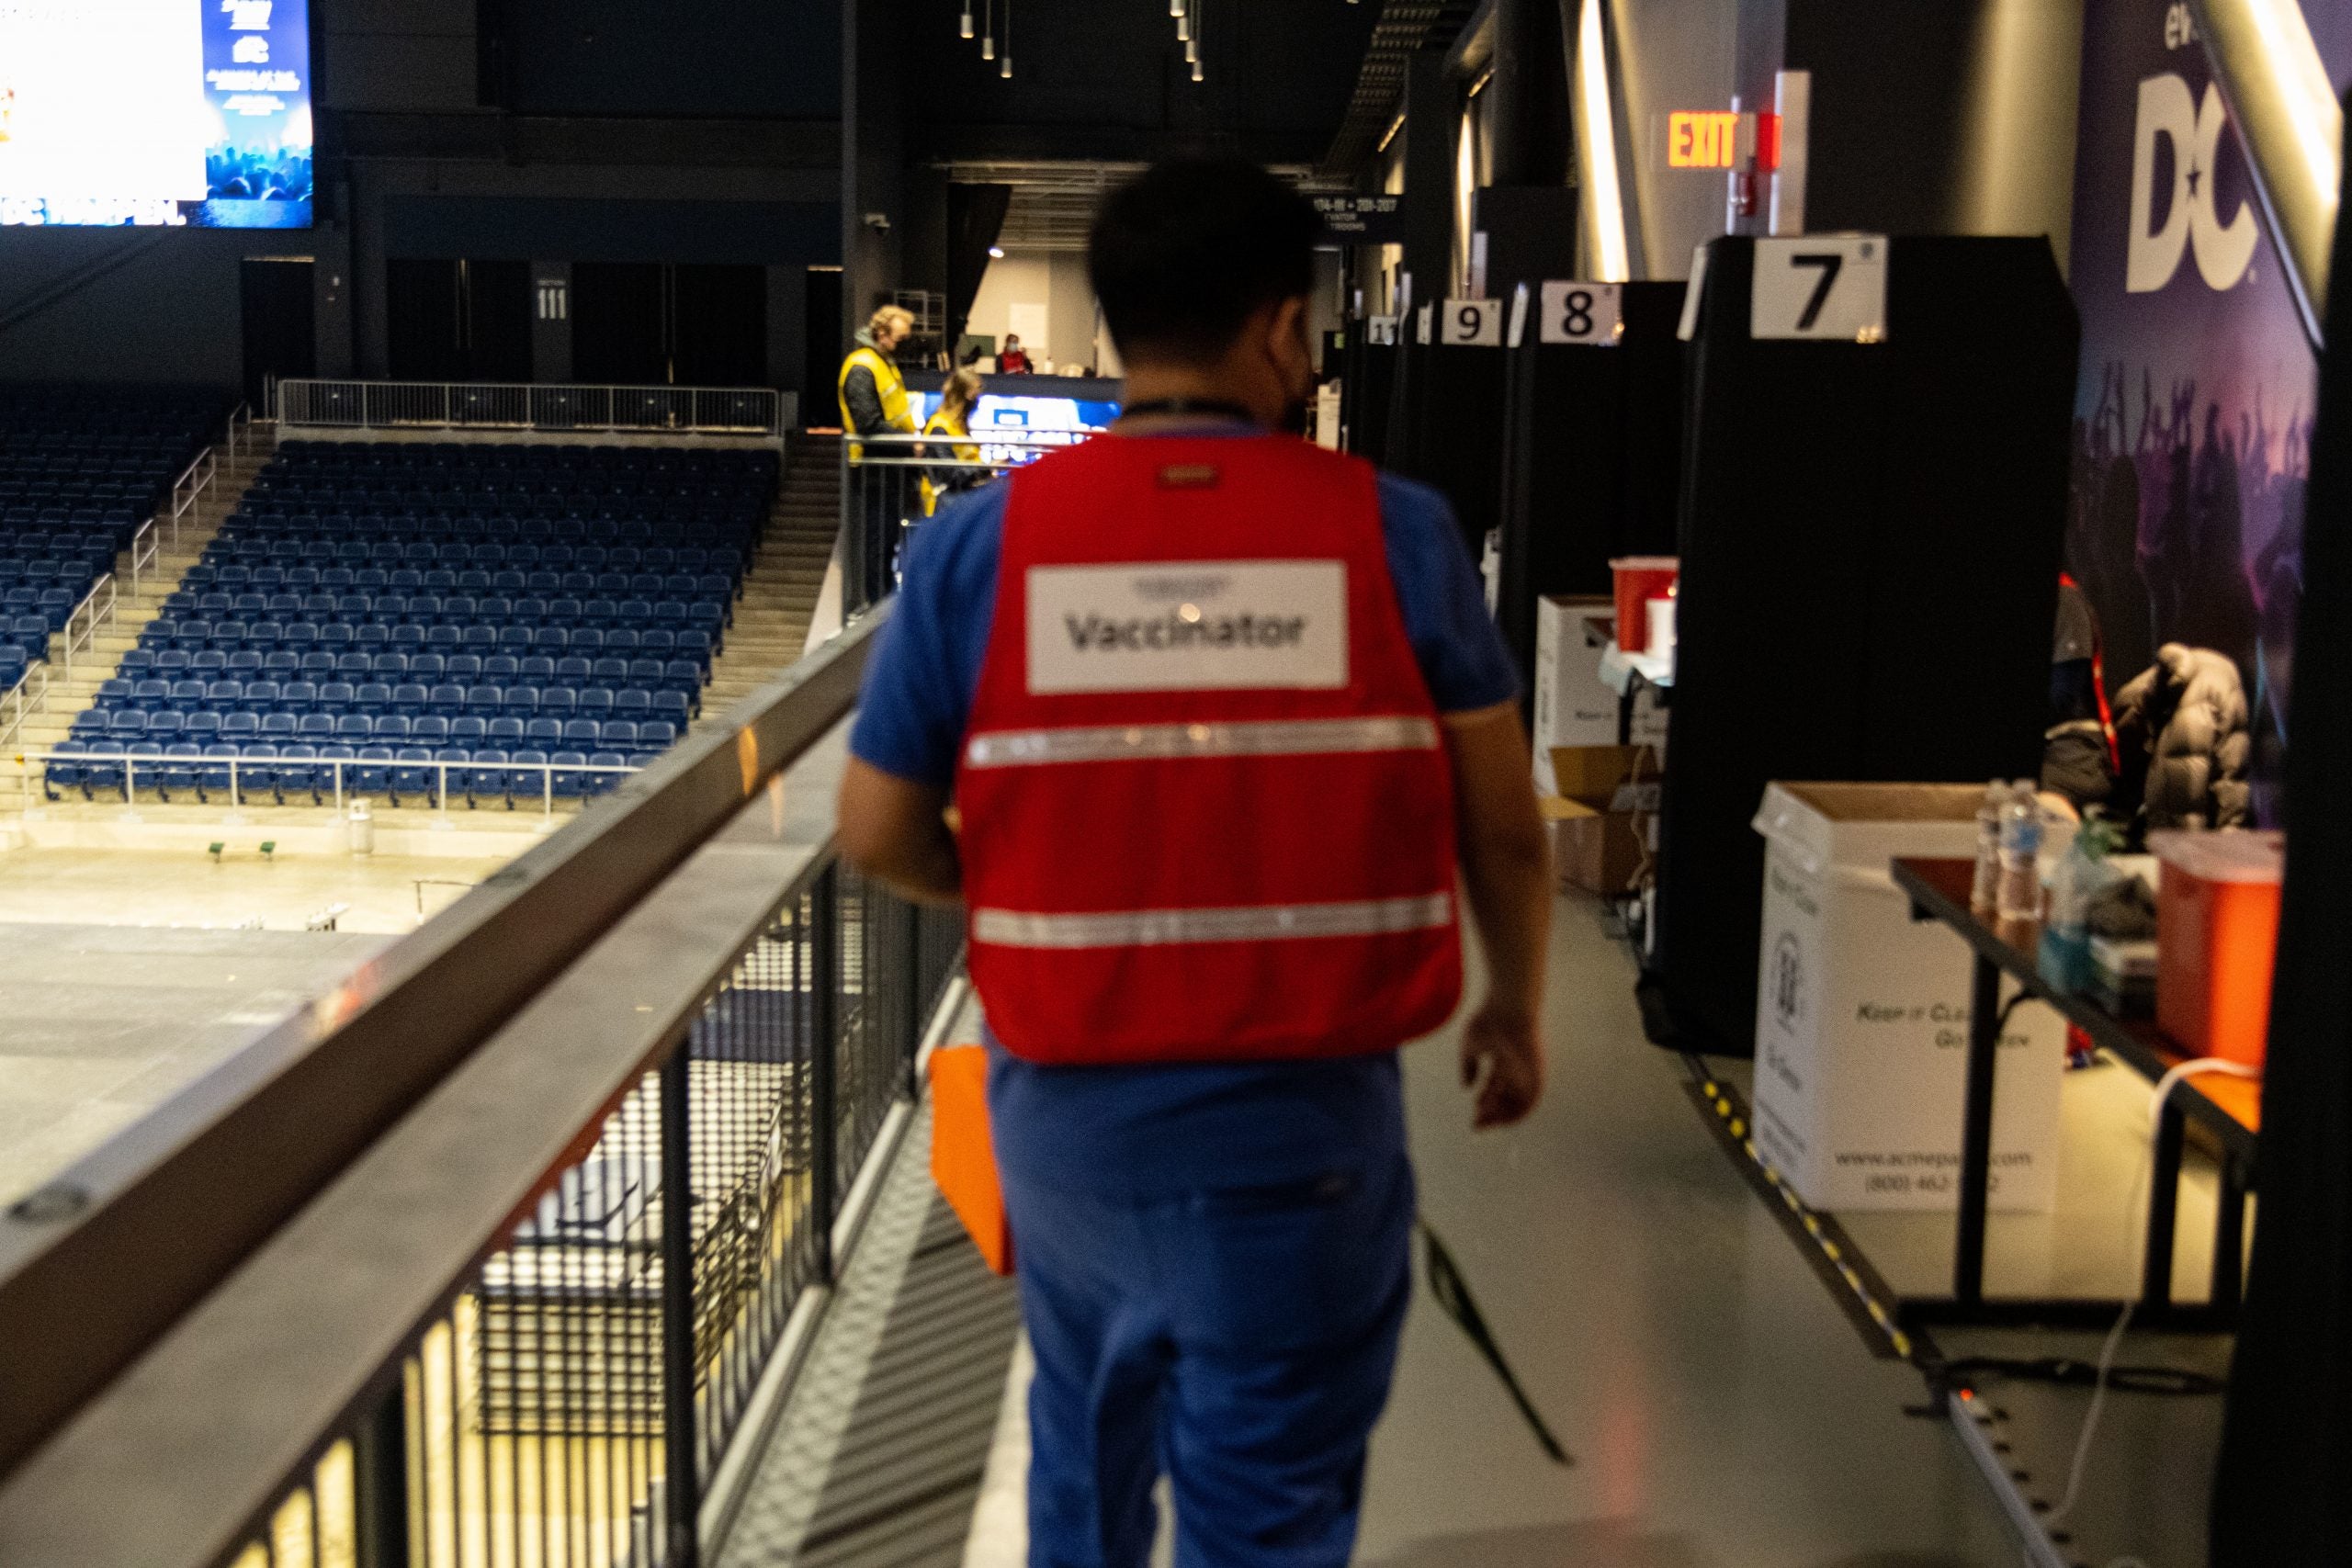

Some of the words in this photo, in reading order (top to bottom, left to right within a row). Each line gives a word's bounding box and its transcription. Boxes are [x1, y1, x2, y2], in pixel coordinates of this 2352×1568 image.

[1669, 111, 1738, 167] EXIT
[2126, 72, 2259, 293] DC
[538, 288, 566, 319] 111
[1790, 255, 1843, 330] 7
[1457, 306, 1481, 341] 9
[1561, 291, 1593, 337] 8
[1066, 610, 1305, 651] Vaccinator
[1835, 1152, 2032, 1168] www.acmepa.com
[1865, 1173, 1910, 1192] (800)
